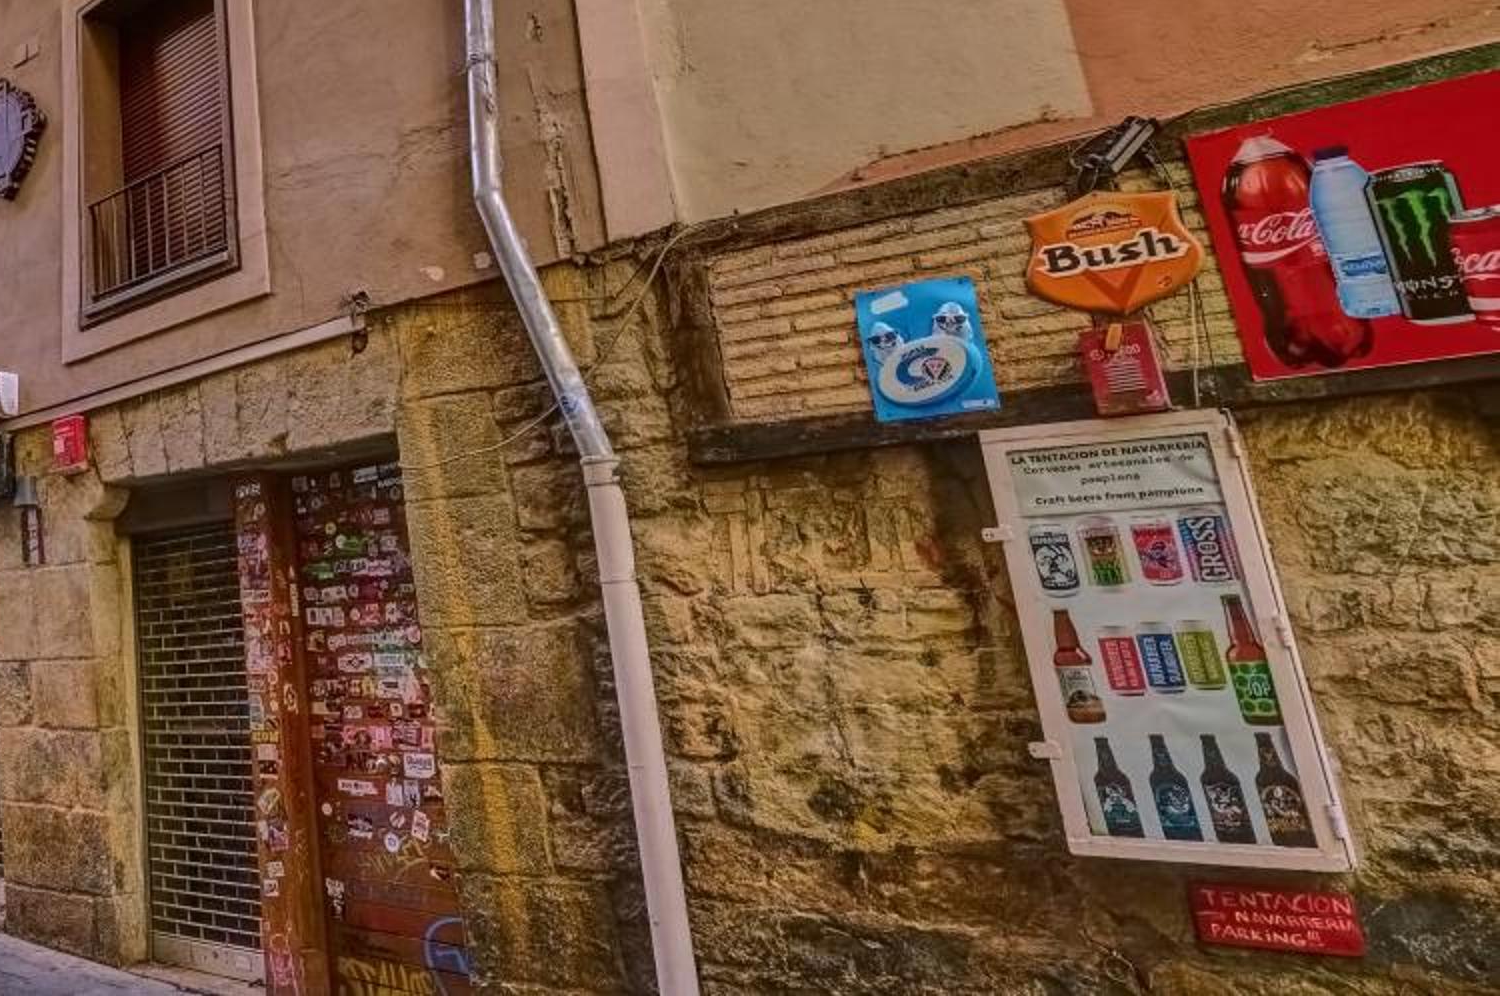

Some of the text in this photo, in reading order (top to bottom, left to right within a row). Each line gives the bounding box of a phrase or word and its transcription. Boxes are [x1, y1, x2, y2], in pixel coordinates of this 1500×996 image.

[1043, 230, 1181, 273] Bush
[1010, 455, 1027, 465] LA
[1028, 449, 1099, 464] TENTACION
[1101, 447, 1119, 457] DE
[1186, 516, 1231, 583] GROSS
[1200, 889, 1352, 914] TENTACION
